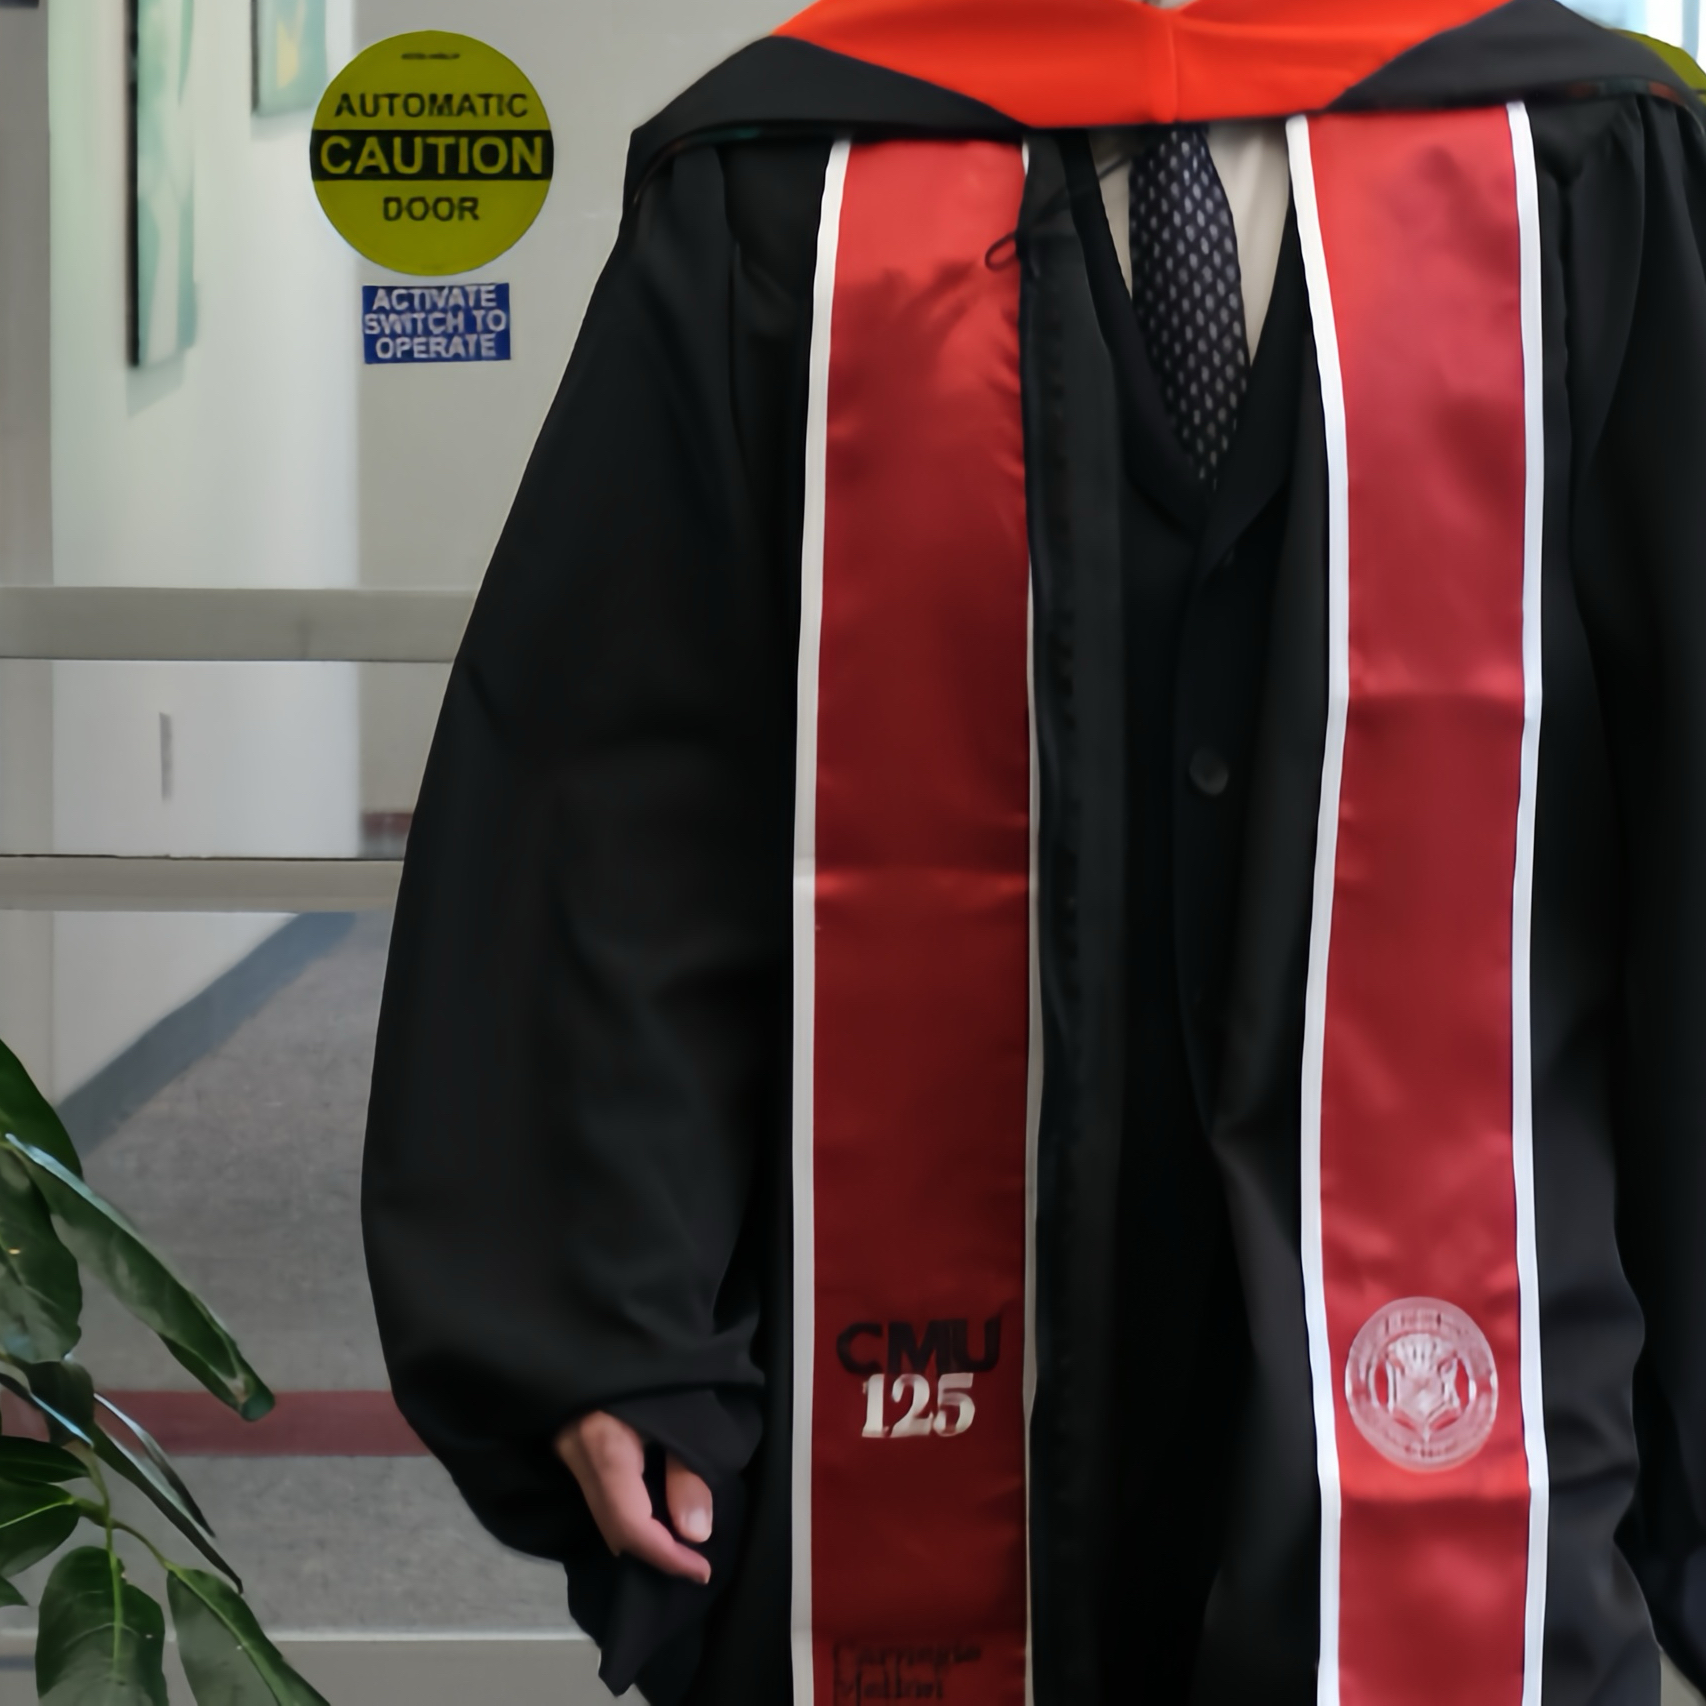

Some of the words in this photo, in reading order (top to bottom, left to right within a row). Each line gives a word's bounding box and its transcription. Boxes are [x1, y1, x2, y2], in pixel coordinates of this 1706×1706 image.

[334, 92, 528, 118] AUTOMATIC
[320, 136, 542, 175] CAUTION
[383, 196, 480, 221] DOOR
[372, 285, 497, 311] ACTIVATE
[364, 309, 464, 335] SWITCH
[472, 309, 506, 332] TO
[375, 333, 497, 359] OPERATE
[836, 1316, 1001, 1376] CMU
[862, 1372, 976, 1438] 125
